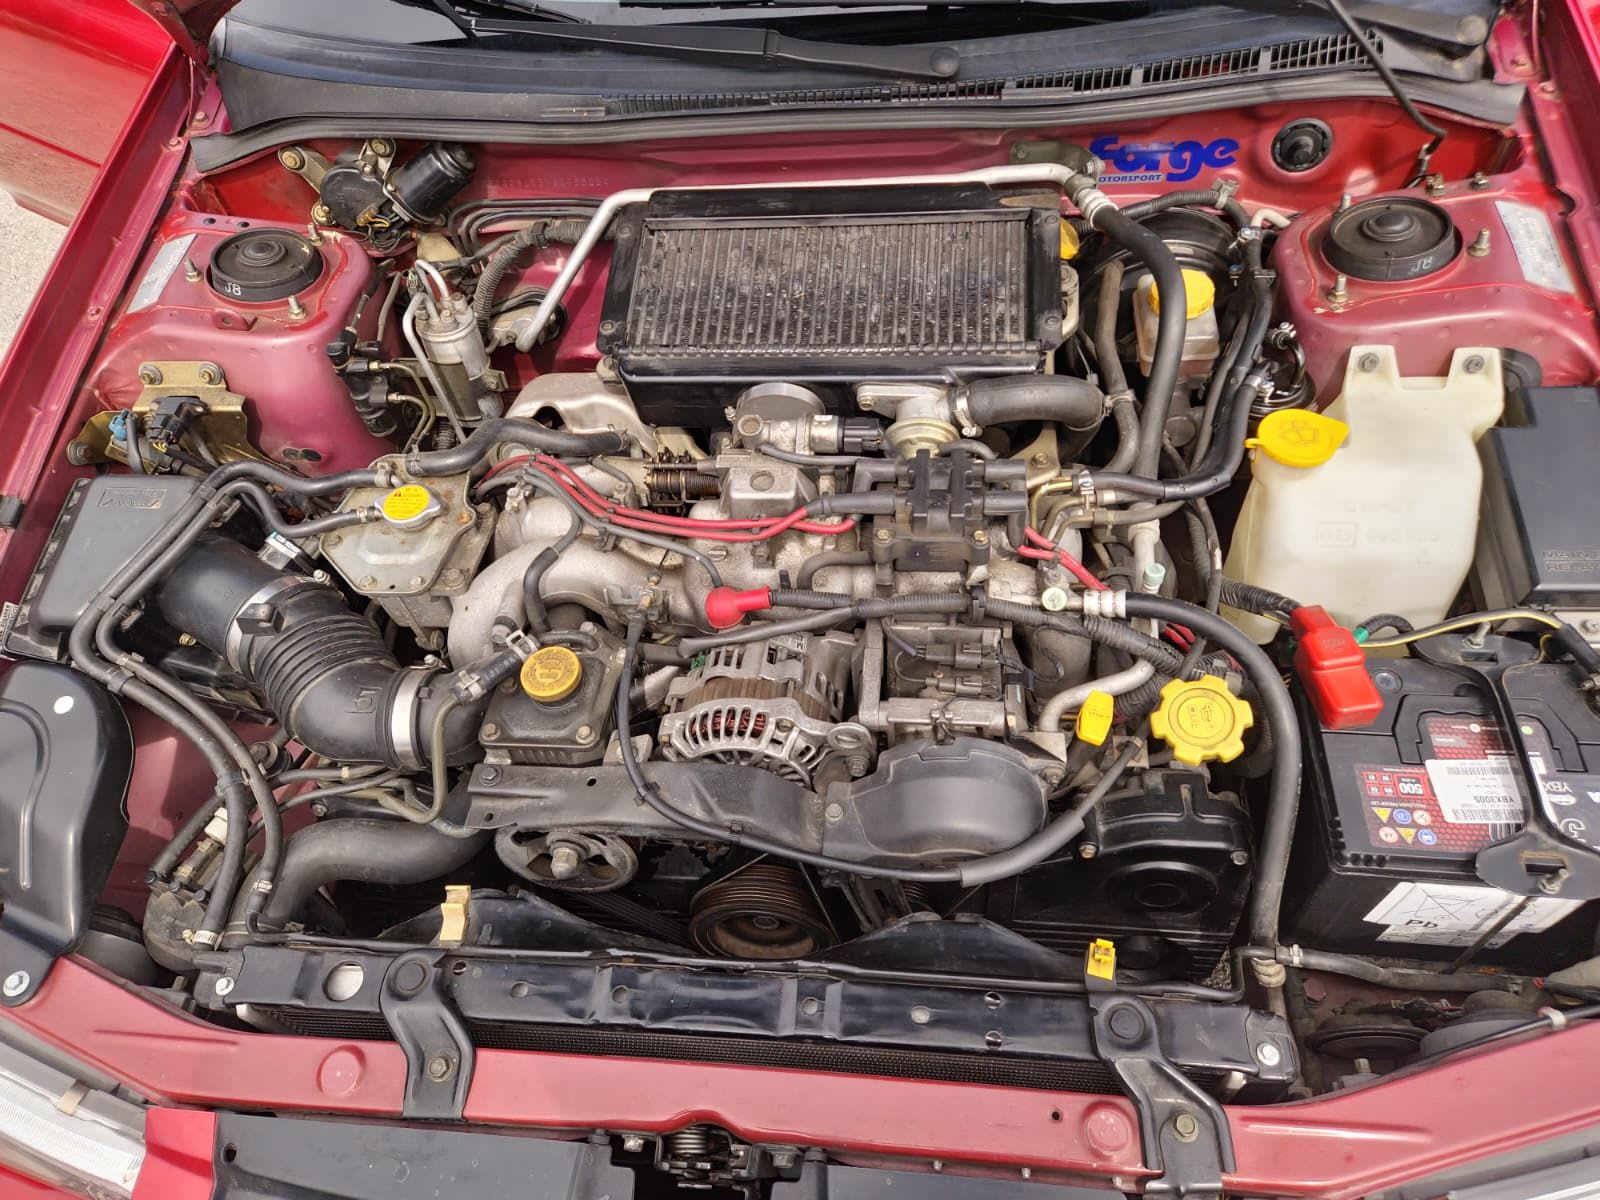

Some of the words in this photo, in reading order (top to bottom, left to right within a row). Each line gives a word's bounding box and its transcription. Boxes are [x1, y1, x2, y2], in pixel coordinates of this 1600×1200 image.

[1097, 174, 1163, 183] OTORSPORT
[1399, 782, 1424, 795] 500
[1405, 918, 1439, 930] Pb
